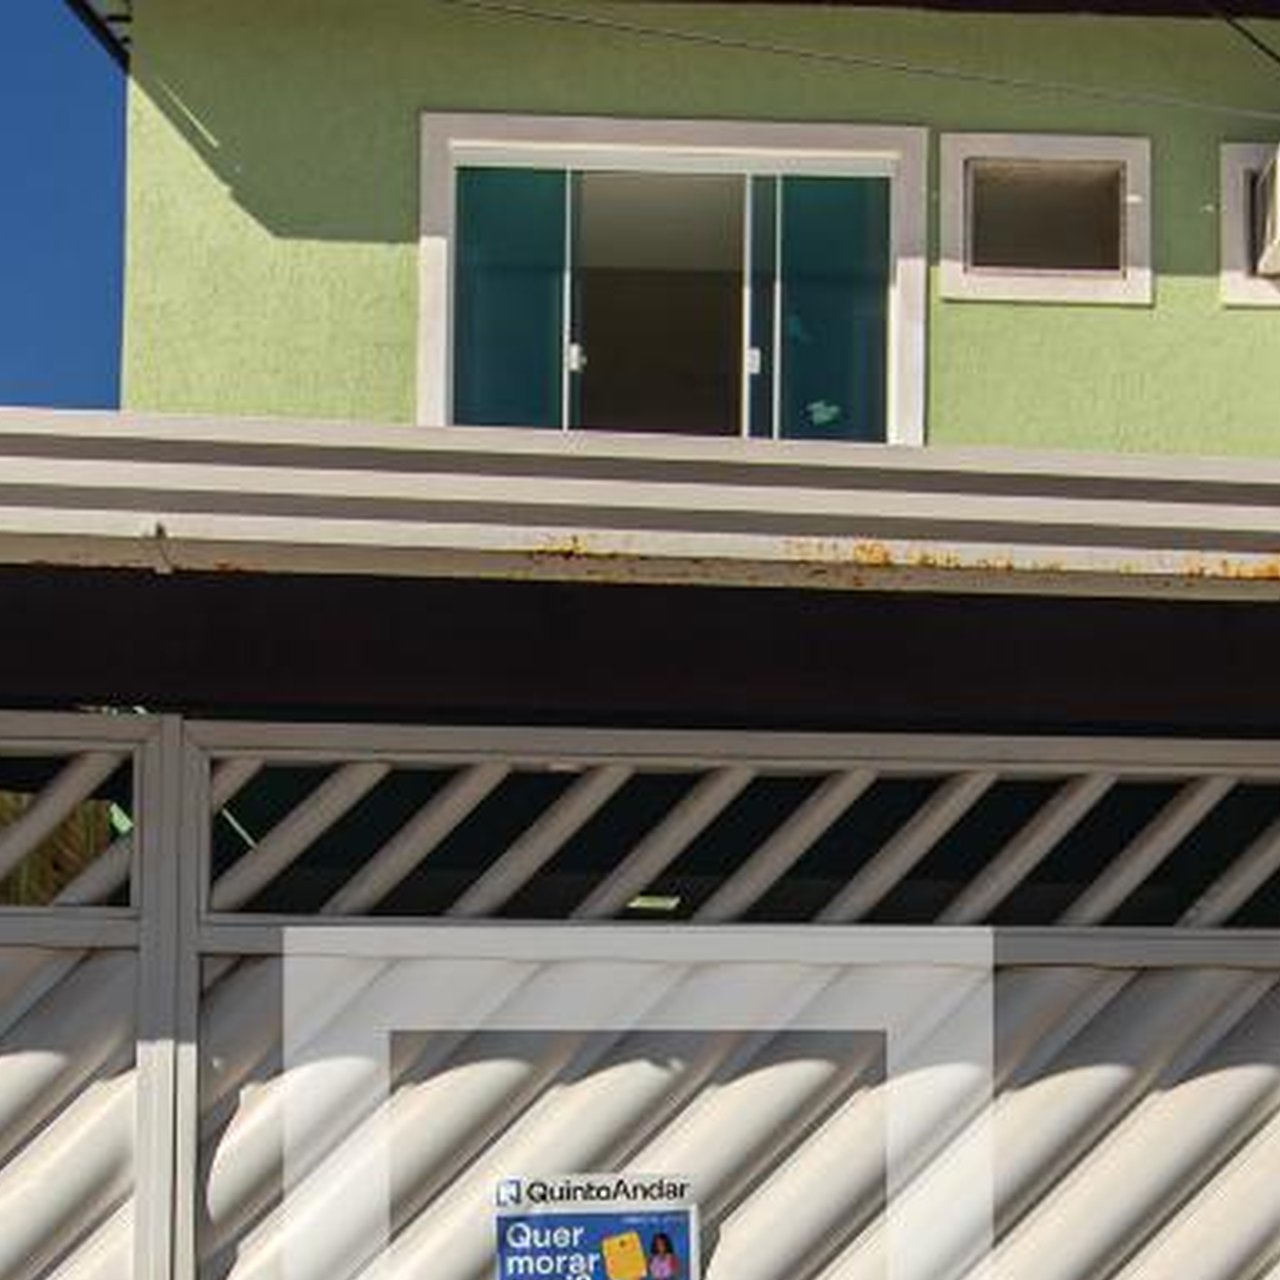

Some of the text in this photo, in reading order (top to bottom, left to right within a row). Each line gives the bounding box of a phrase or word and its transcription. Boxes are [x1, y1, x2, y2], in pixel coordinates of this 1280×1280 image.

[526, 1179, 689, 1203] QuintoAndar
[506, 1222, 585, 1249] Quer
[506, 1252, 601, 1276] morar
